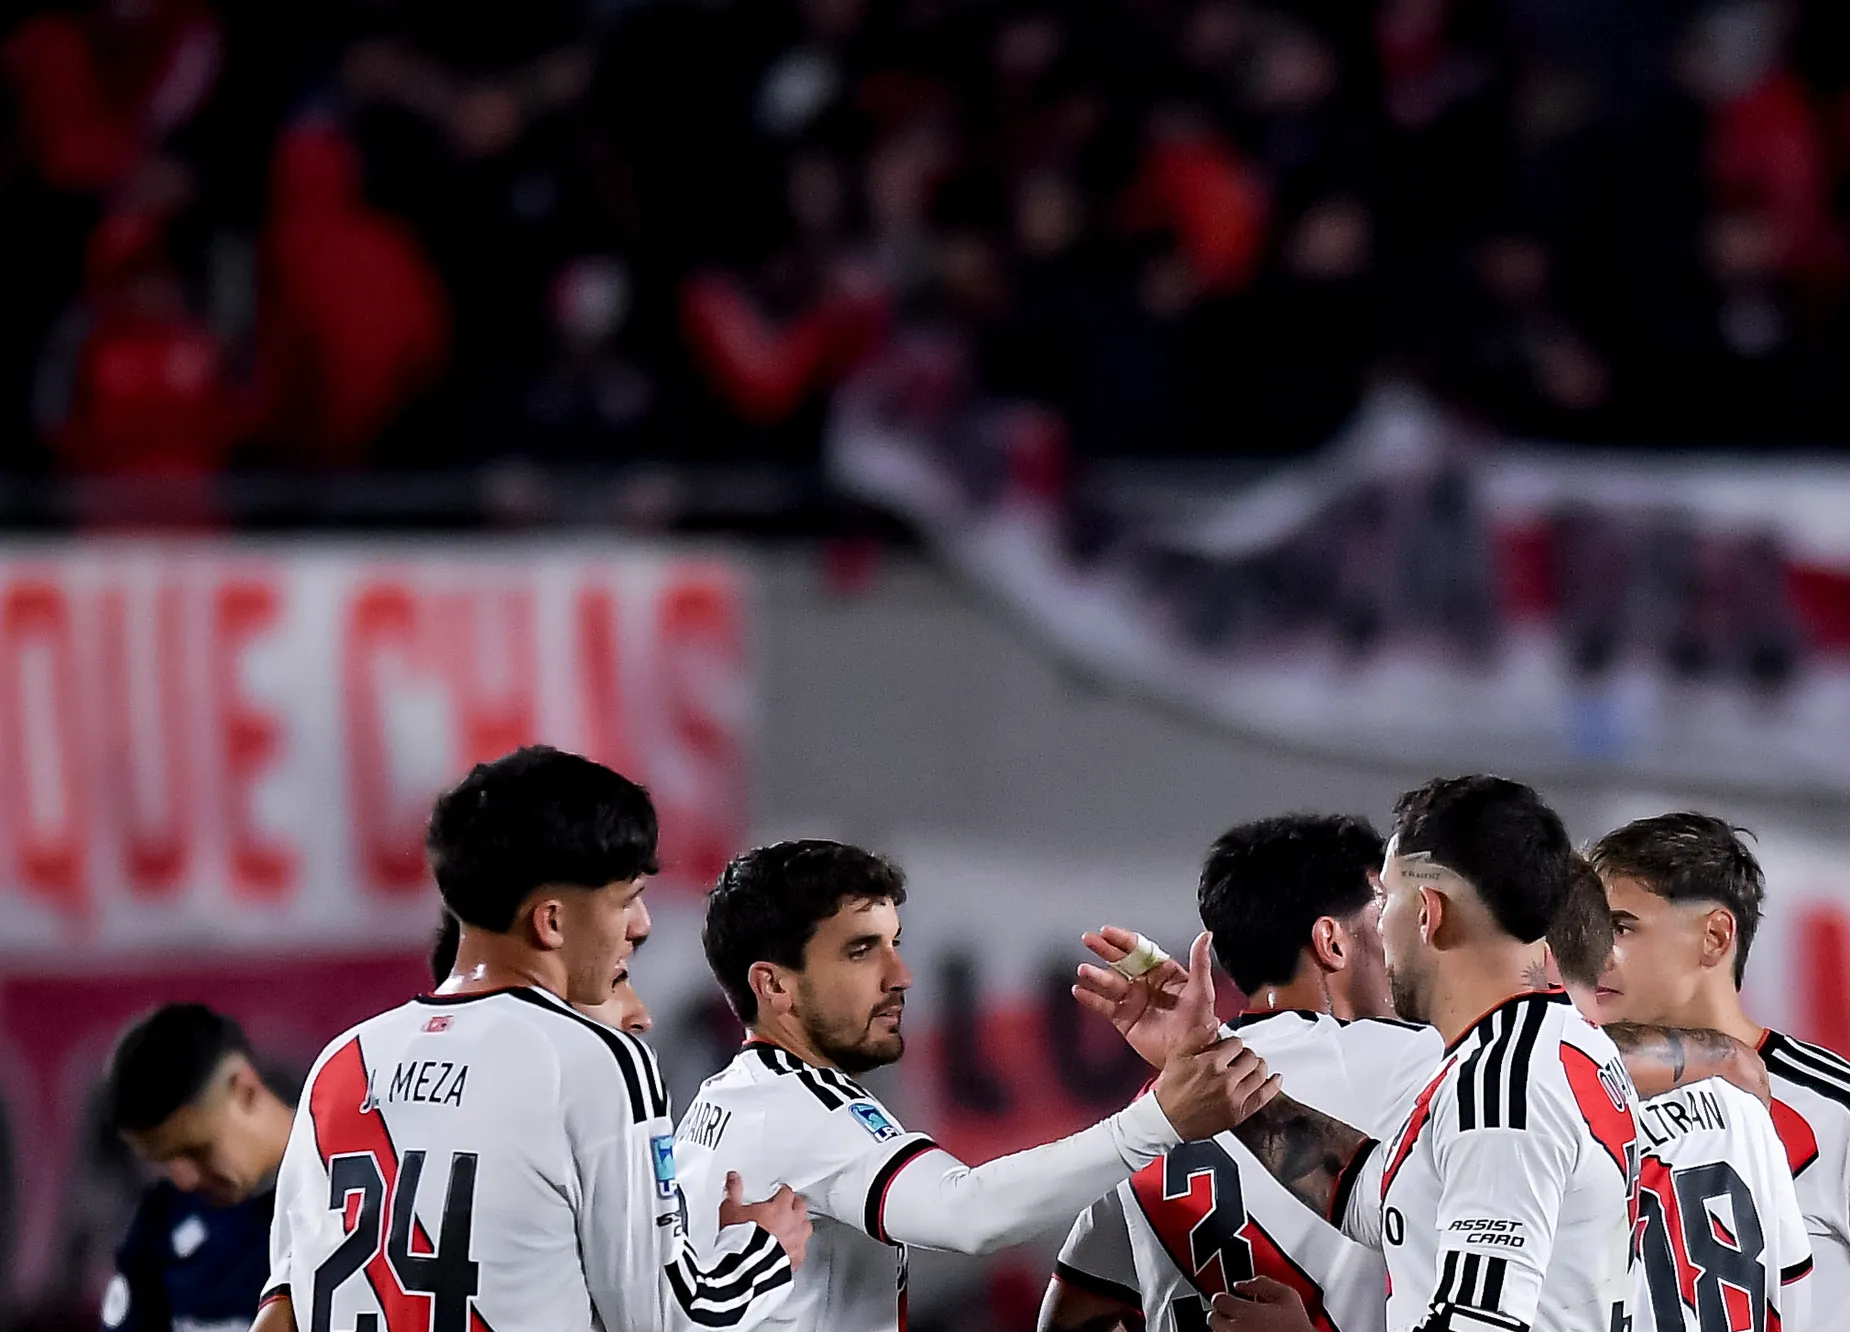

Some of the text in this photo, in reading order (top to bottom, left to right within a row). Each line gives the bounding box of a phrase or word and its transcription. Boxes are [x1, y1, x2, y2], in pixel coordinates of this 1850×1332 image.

[388, 1060, 469, 1108] MEZA
[1448, 1219, 1523, 1233] ASSIST
[1466, 1233, 1525, 1248] CARD
